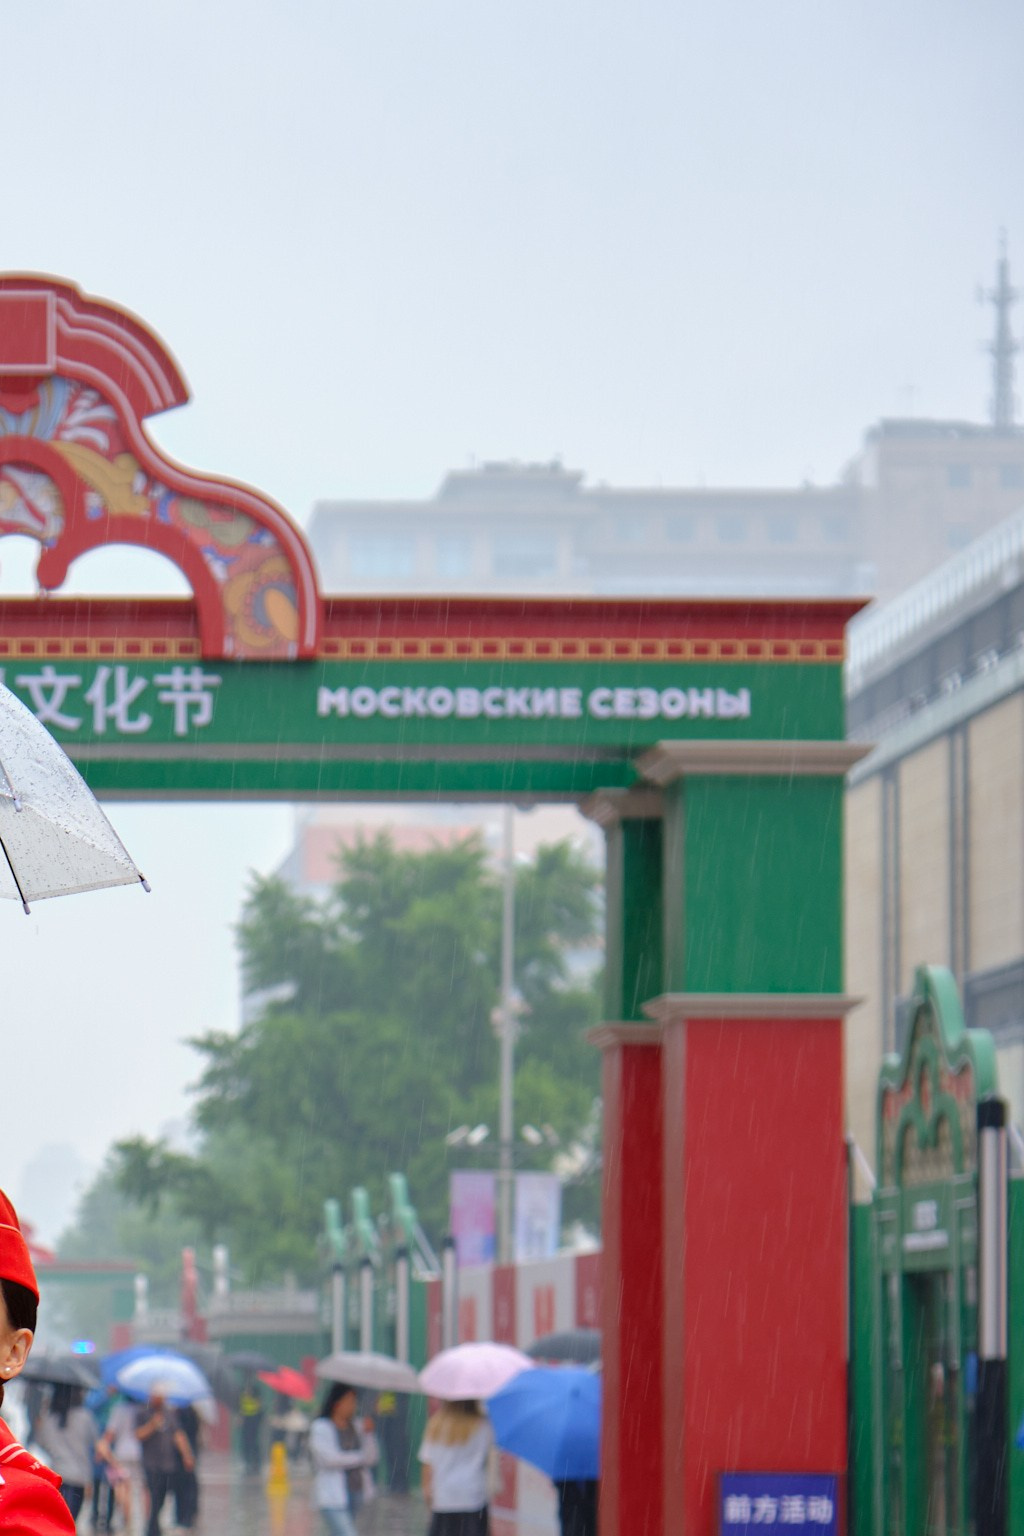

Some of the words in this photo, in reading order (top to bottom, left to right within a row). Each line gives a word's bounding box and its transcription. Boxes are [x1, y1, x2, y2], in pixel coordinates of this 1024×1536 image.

[316, 686, 583, 718] МОСКОВСКИЕ
[588, 686, 752, 718] СЕЗОНЫ
[724, 1494, 834, 1525] 前方活动
